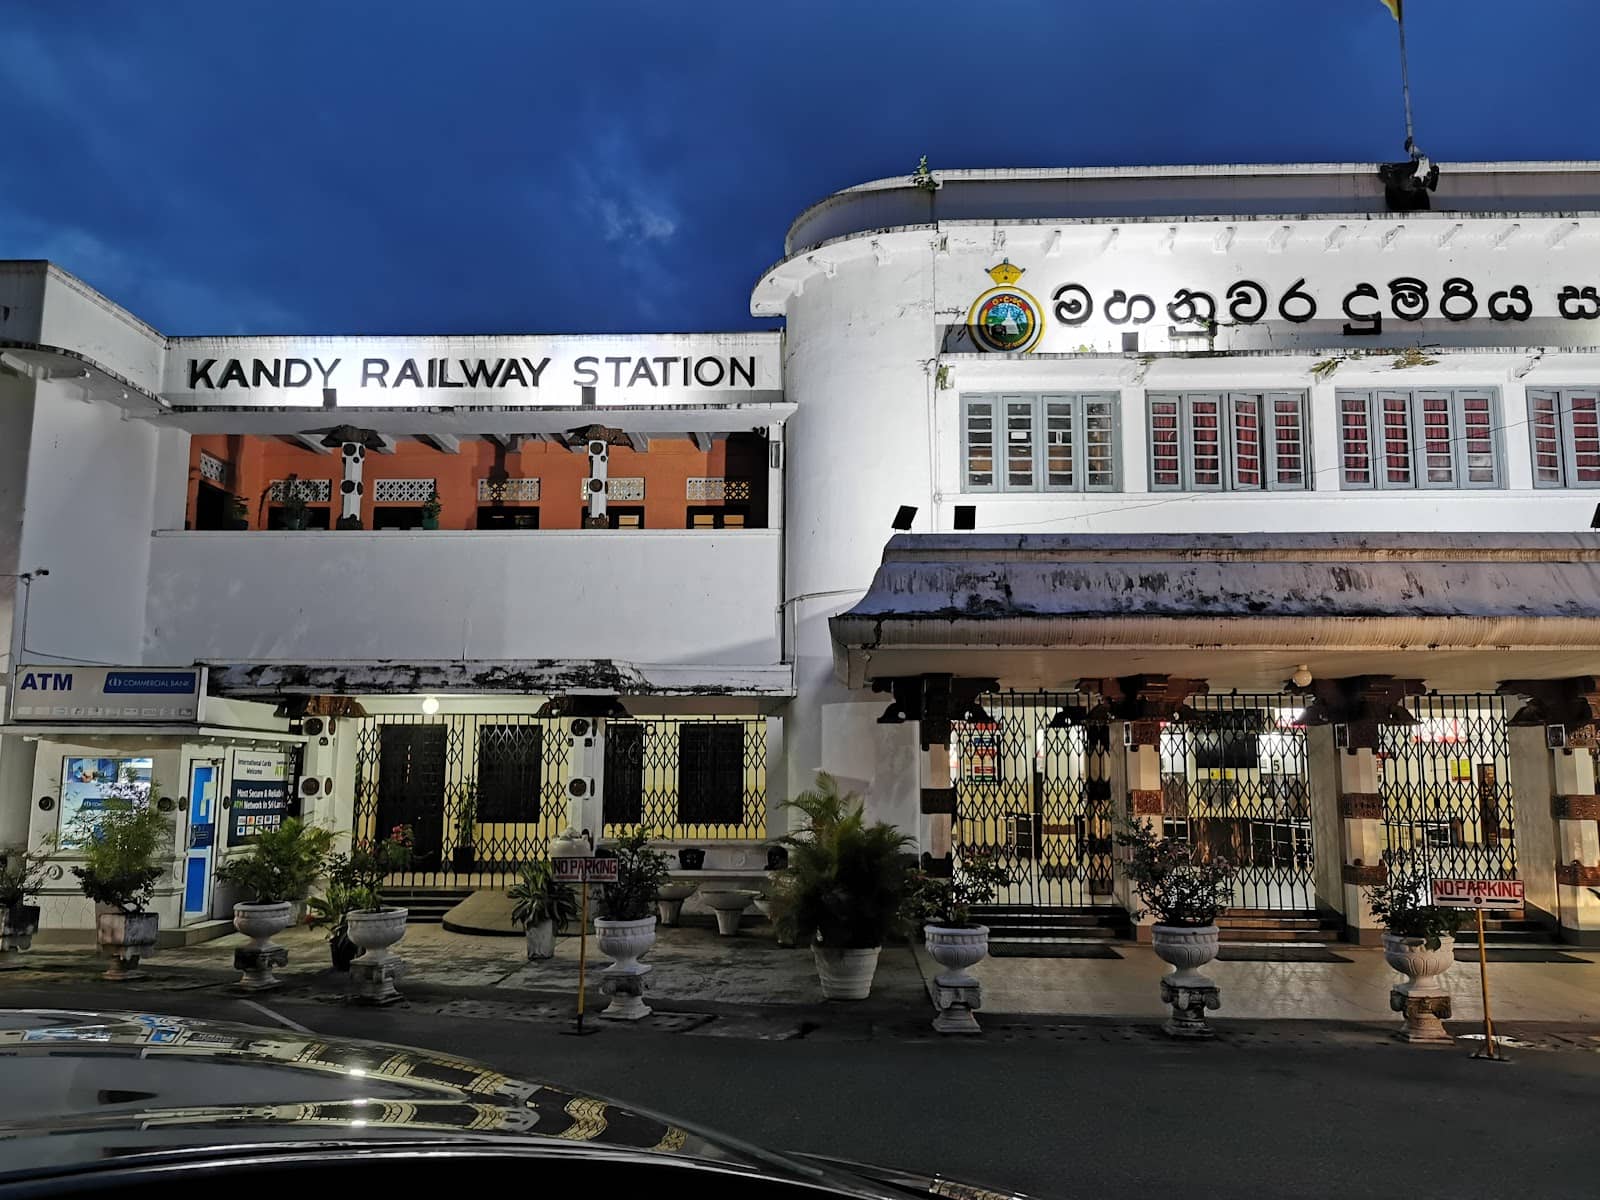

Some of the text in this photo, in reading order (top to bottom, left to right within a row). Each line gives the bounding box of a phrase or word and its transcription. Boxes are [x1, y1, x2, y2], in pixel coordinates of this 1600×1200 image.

[1053, 278, 1317, 337] මහනුවර
[1343, 277, 1533, 335] දුම්රිය
[189, 356, 755, 389] KANDY RAILWAY STATION
[21, 673, 191, 691] ATM COMMERCIAL BANK
[238, 759, 261, 767] International
[1273, 760, 1280, 771] 5
[237, 788, 248, 798] Most
[249, 788, 263, 798] Secure
[244, 801, 261, 810] Network
[553, 860, 617, 874] NO PARKING
[1434, 881, 1523, 898] NO PARKING
